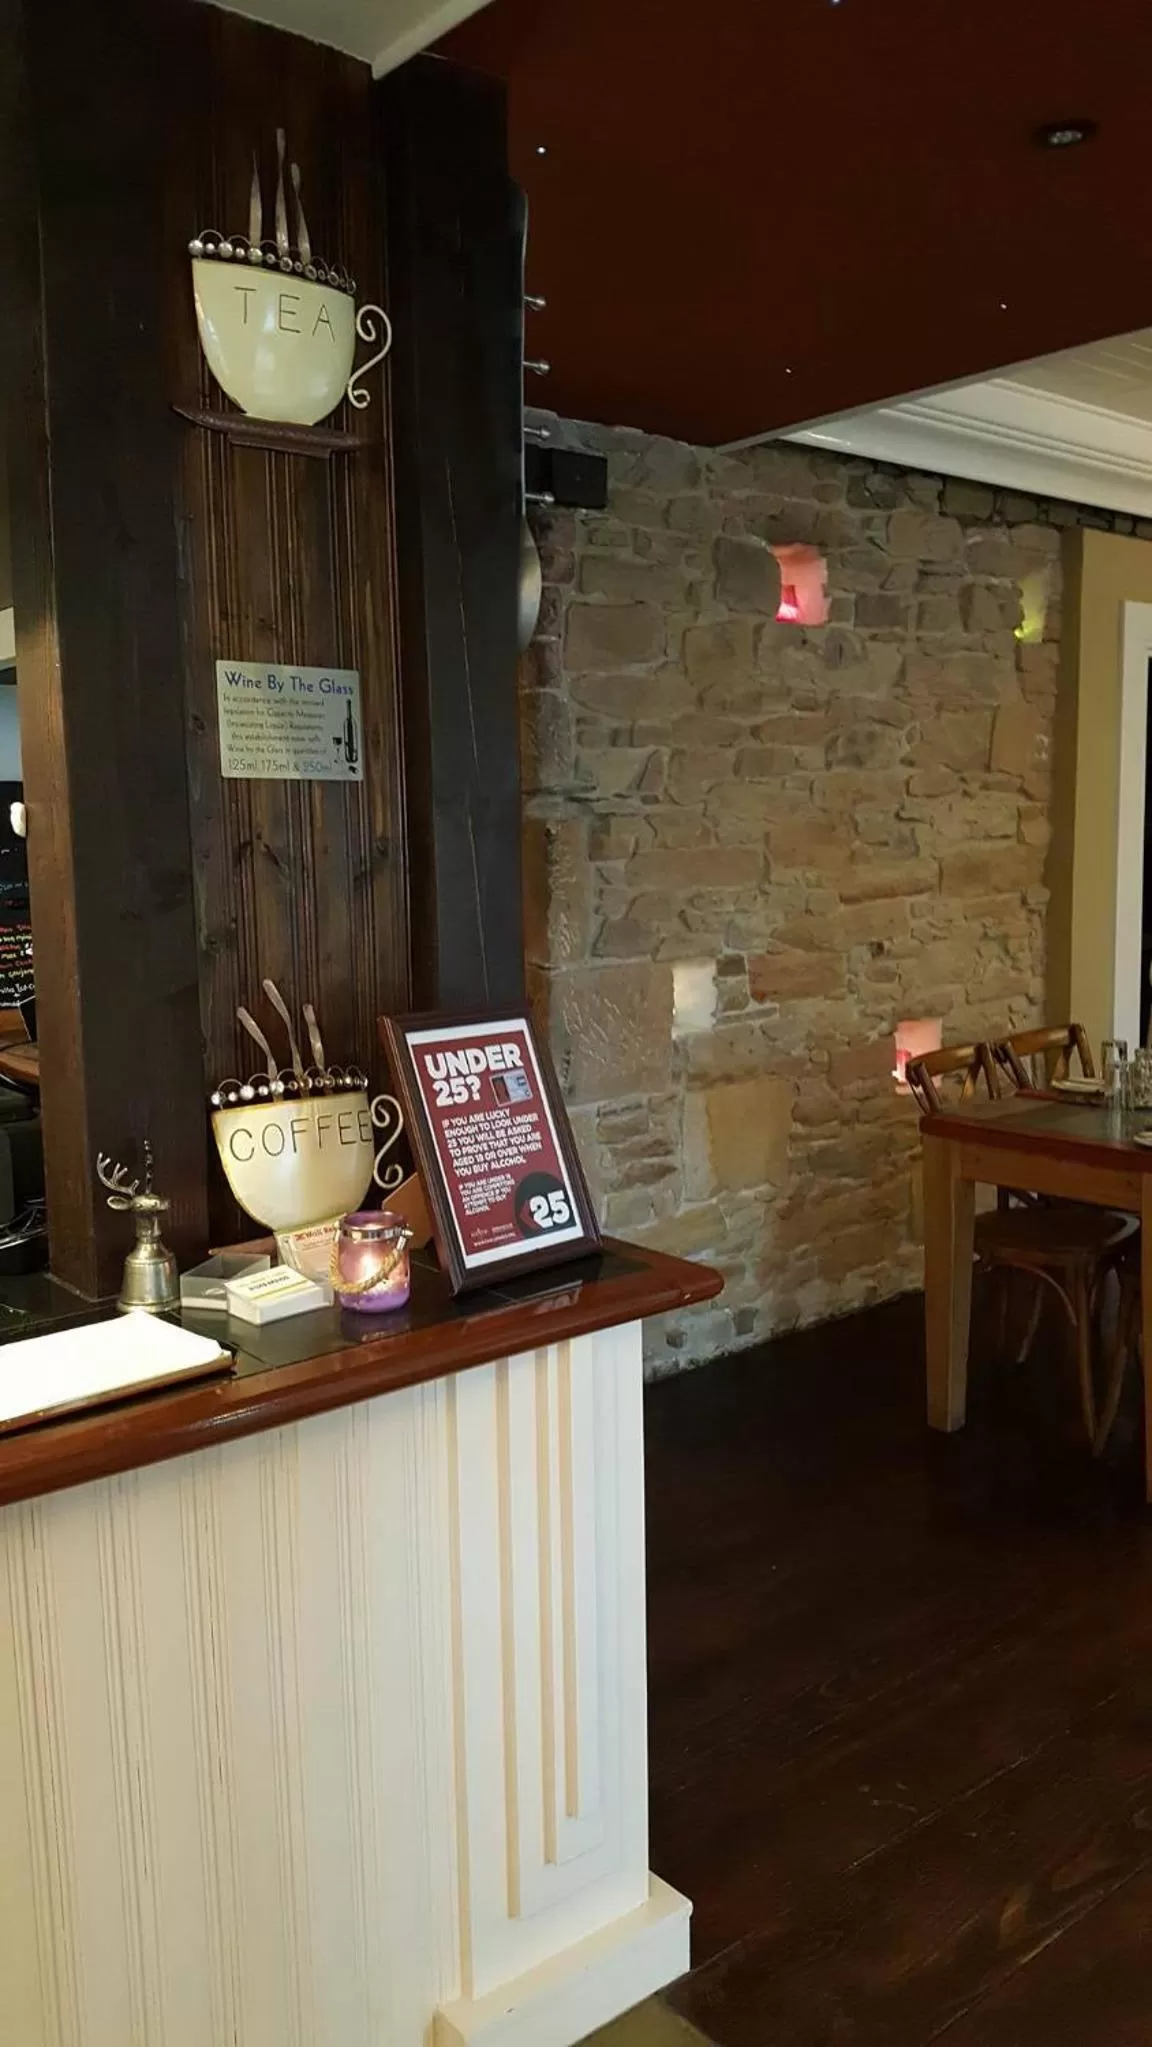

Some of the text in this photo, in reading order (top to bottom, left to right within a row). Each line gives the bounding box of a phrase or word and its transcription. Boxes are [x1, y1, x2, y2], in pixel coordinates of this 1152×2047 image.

[234, 286, 336, 343] TEA
[224, 671, 353, 695] Wine By The Glass
[424, 1043, 524, 1079] UNDER
[432, 1077, 481, 1107] 25?
[444, 1113, 539, 1138] ENOUGH TO LOOK UNDER
[450, 1117, 468, 1127] YOU
[468, 1113, 485, 1124] ARE
[485, 1108, 510, 1121] LUCKY
[229, 1109, 373, 1163] COFFEE
[447, 1125, 532, 1149] 25 YOU WILL BE ASKED
[449, 1132, 542, 1158] TO PROVE THAT YOU ARE
[452, 1142, 543, 1168] AGED 18 OR OVER WHEN
[453, 1167, 472, 1178] YOU
[472, 1163, 490, 1174] BUY
[529, 1190, 570, 1229] 25
